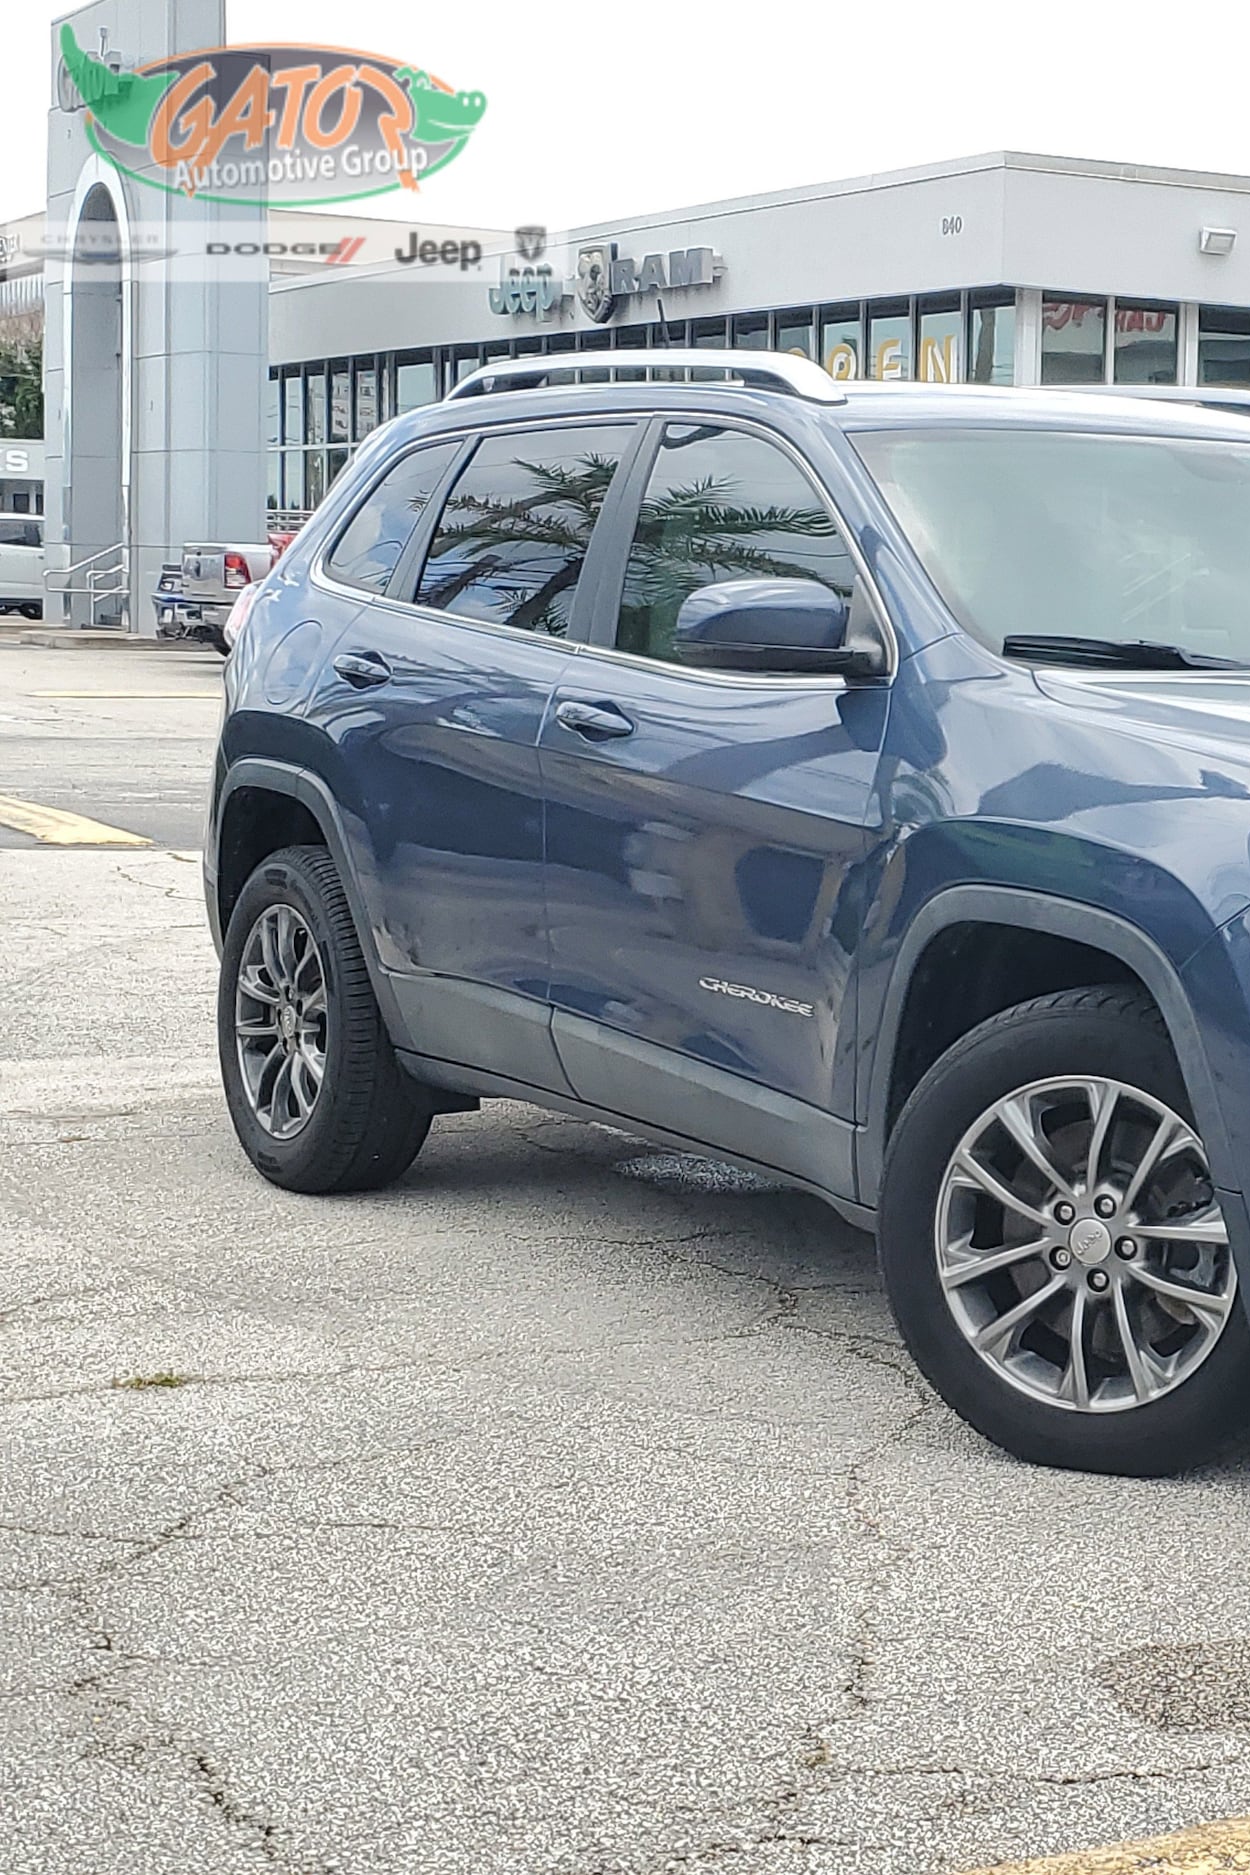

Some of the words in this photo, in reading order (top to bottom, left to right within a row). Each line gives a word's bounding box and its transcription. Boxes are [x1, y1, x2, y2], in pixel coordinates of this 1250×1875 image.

[489, 258, 553, 323] Jeep
[611, 247, 714, 295] RAM
[698, 976, 814, 1018] CHEROKEE
